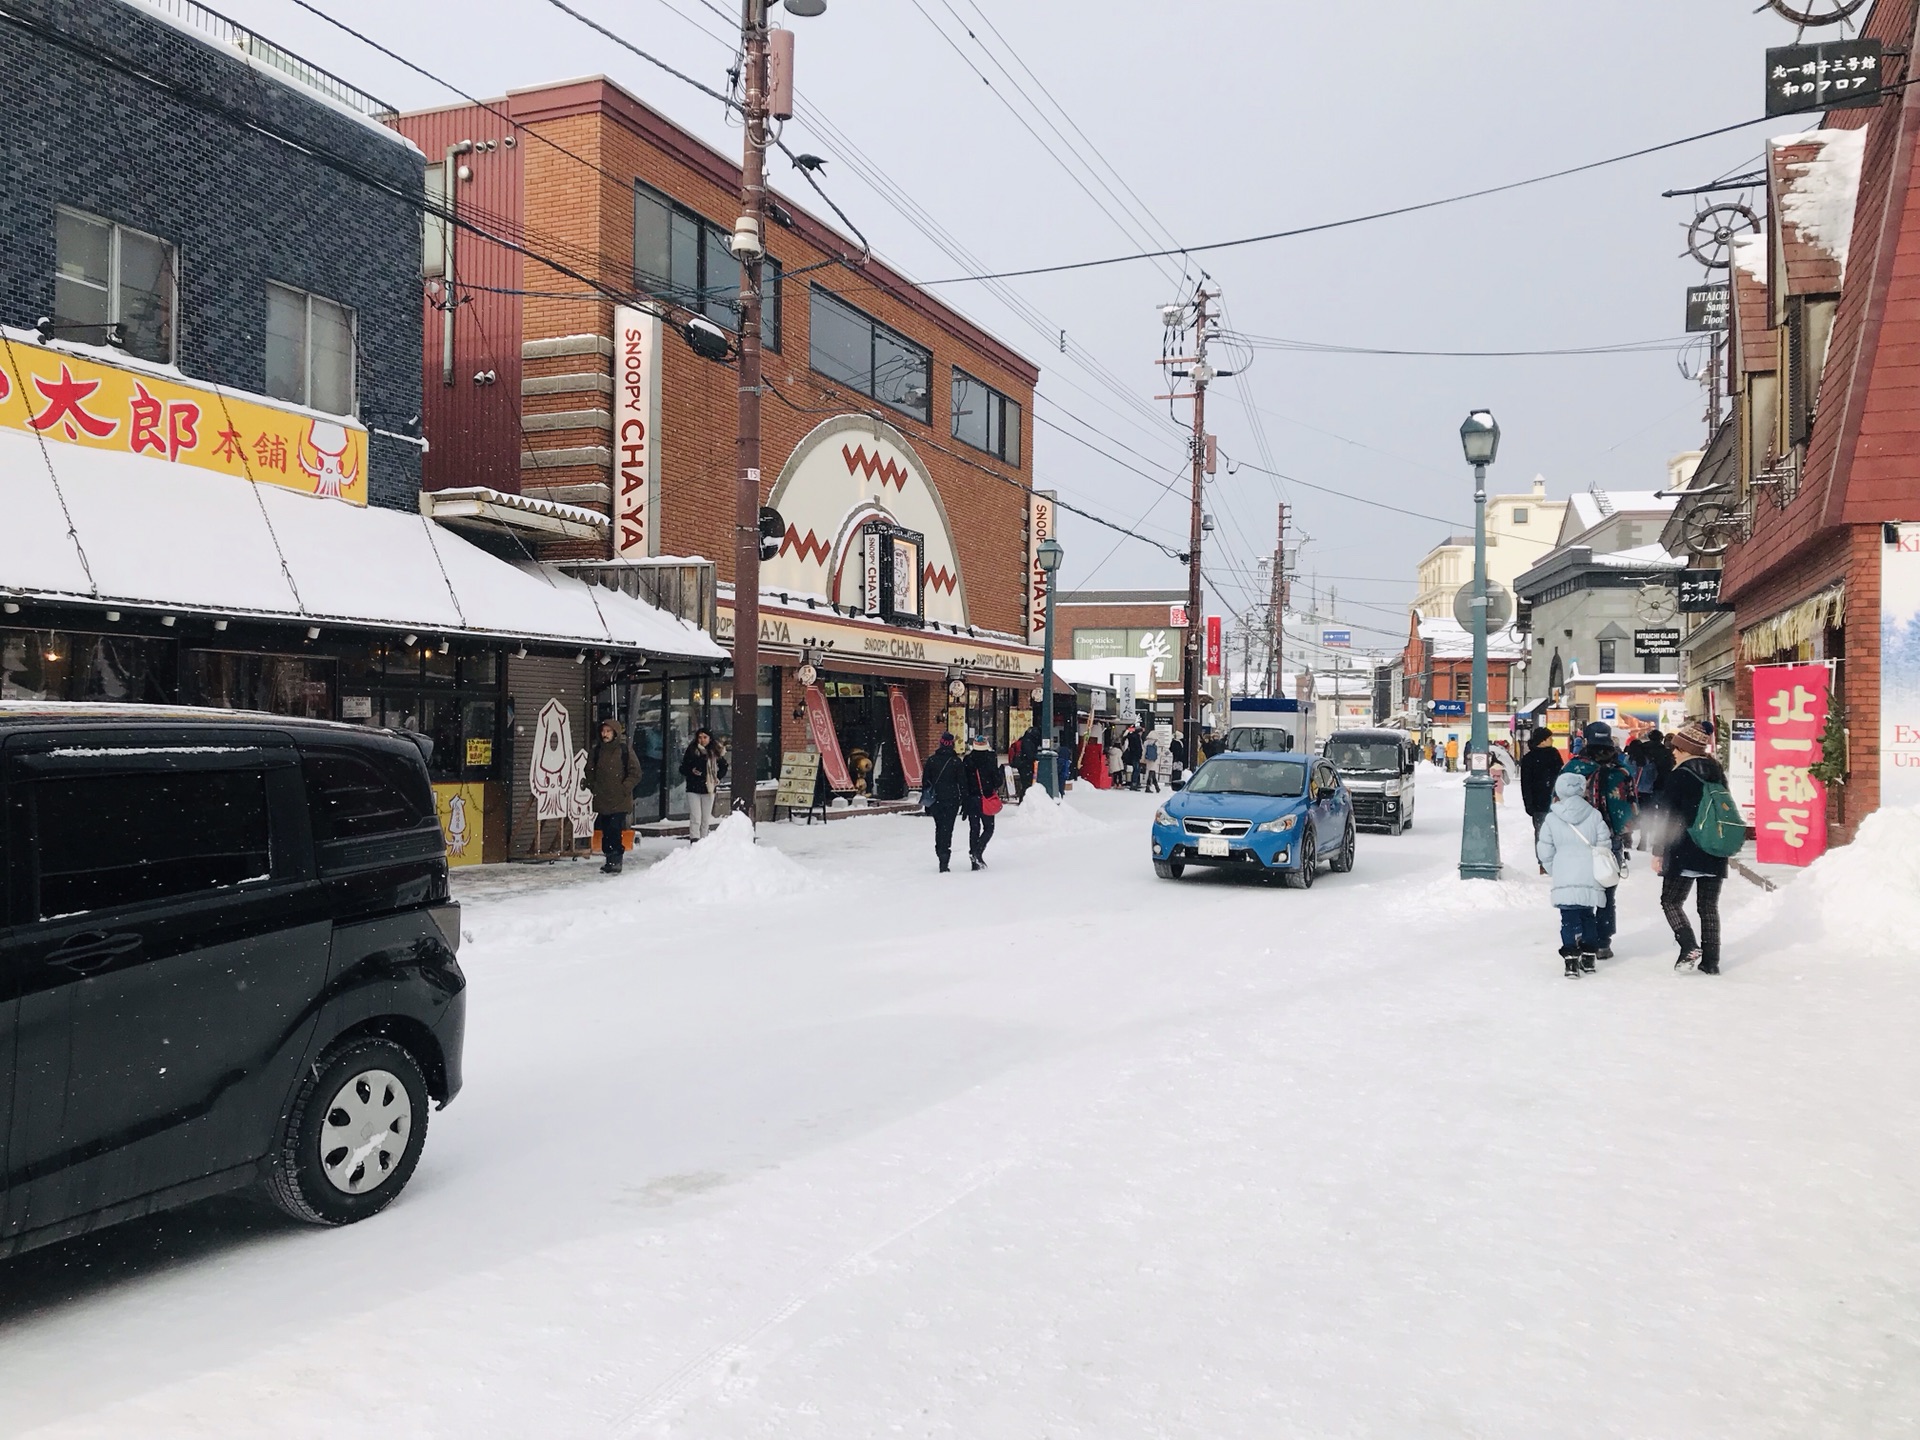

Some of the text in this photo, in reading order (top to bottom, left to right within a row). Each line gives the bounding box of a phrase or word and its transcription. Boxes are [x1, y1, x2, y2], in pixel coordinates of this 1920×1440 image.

[1772, 55, 1877, 79] 北一硝子三号館
[1782, 76, 1867, 97] 和のフロア
[620, 329, 645, 552] SNOOPY CHA-YA
[867, 537, 877, 611] SNOOPY CHA-YA
[1682, 580, 1720, 591] 北一硝子
[864, 637, 890, 653] SNOOPY
[1076, 636, 1114, 645] Chop sticks
